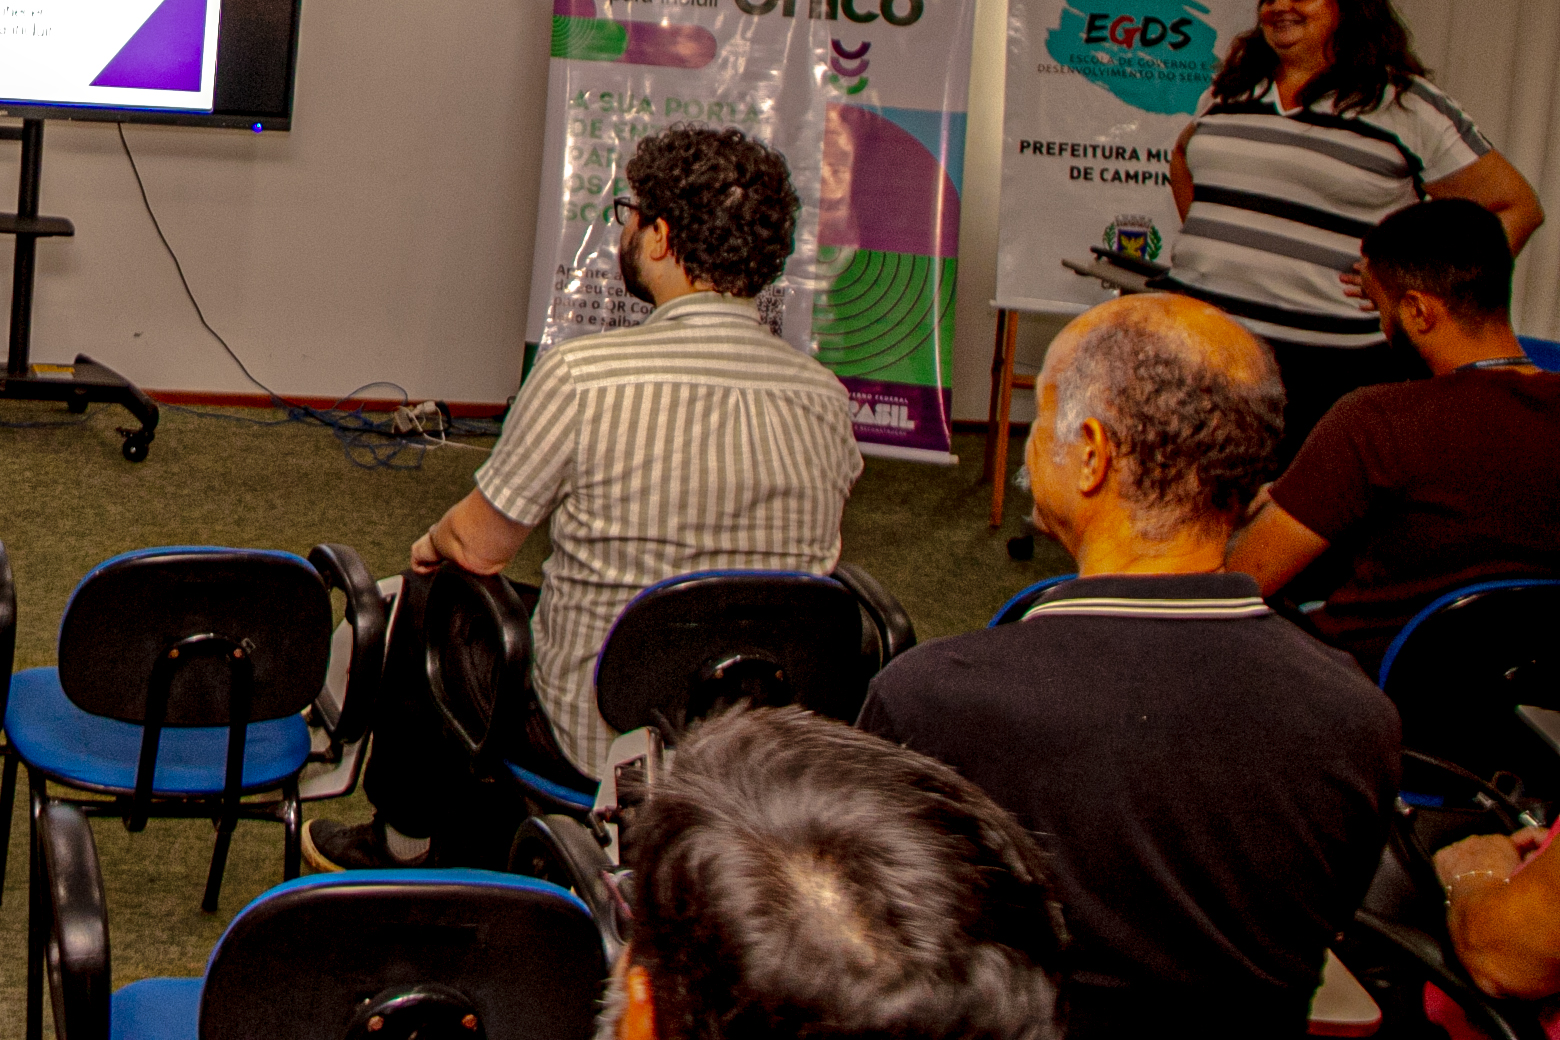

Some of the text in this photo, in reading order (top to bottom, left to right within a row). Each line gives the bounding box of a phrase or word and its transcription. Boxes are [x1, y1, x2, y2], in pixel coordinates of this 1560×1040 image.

[1083, 13, 1193, 52] EGDS
[1069, 53, 1115, 66] ESCOLA
[1118, 56, 1136, 67] DE
[1141, 58, 1197, 71] GOVERNO
[1037, 64, 1210, 83] DESENVOLVIMENTO DO SERV
[573, 90, 762, 123] A SUA PORTA
[572, 118, 604, 138] DE
[569, 146, 622, 168] PAR
[1019, 140, 1141, 161] PREFEITURA
[1070, 166, 1172, 186] DE CAMPIN
[592, 300, 600, 310] o
[607, 301, 626, 314] QR
[875, 394, 909, 404] FEDERAL
[849, 400, 915, 430] RASIL
